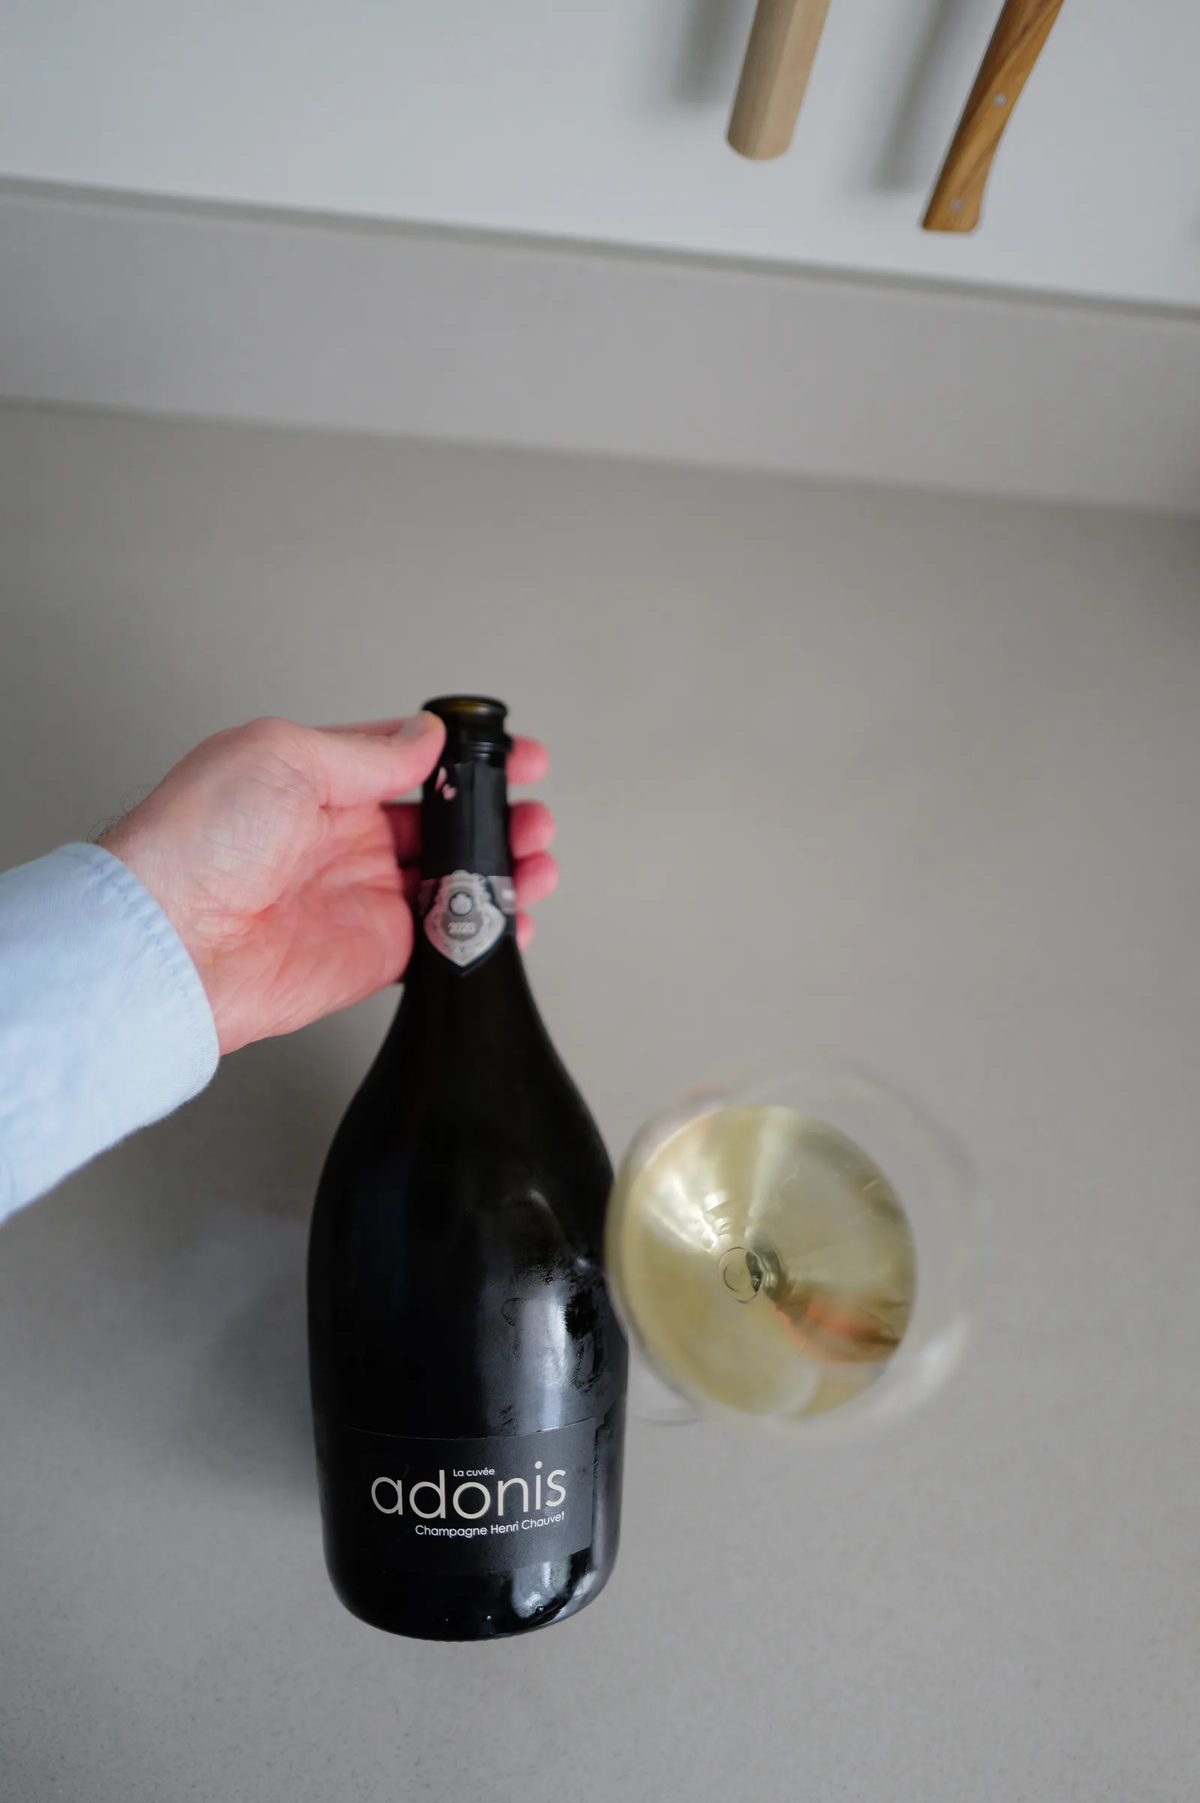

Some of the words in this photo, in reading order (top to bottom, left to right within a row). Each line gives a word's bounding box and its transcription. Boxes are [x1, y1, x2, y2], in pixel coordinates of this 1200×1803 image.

[453, 1468, 464, 1477] La
[466, 1466, 495, 1477] cuvée
[371, 1461, 566, 1519] adonis
[415, 1525, 488, 1538] Champagne
[491, 1521, 519, 1534] Henri
[521, 1511, 565, 1531] Chauvet
